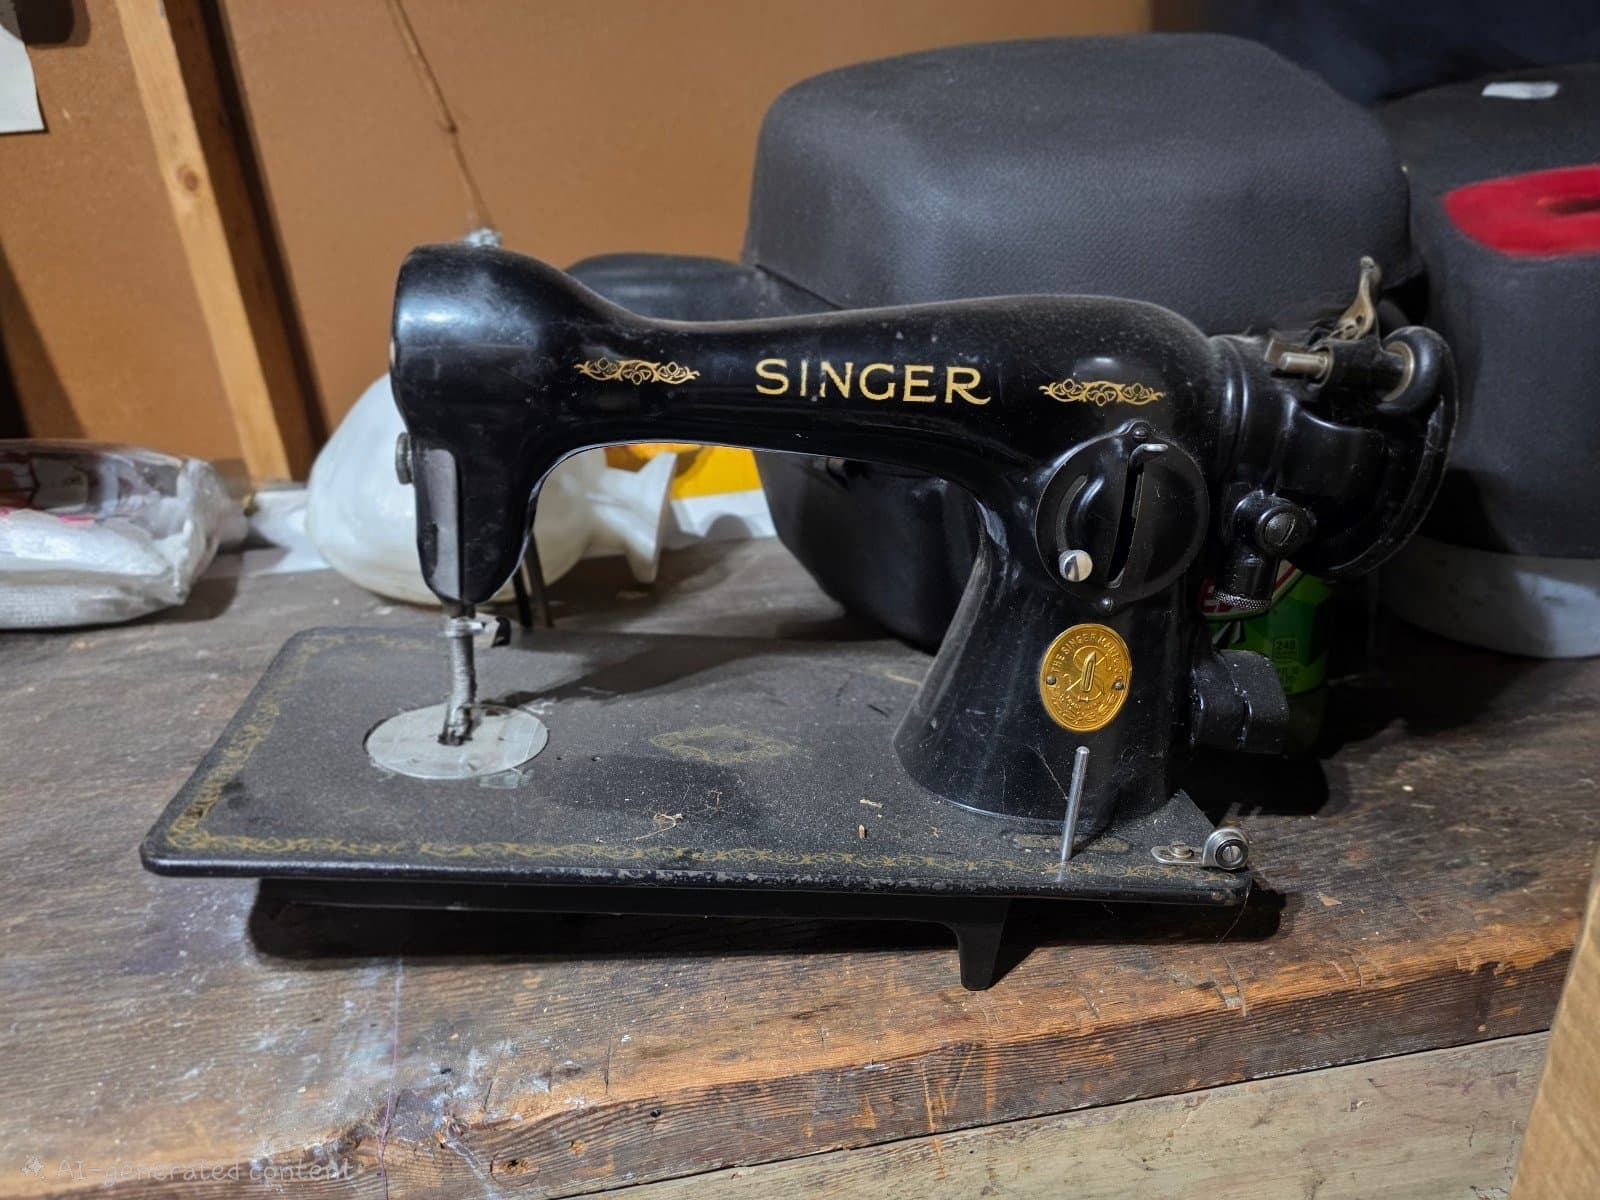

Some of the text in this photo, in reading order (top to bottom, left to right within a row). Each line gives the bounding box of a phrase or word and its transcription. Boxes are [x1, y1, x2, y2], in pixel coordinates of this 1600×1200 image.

[755, 358, 992, 405] SINGER
[1051, 653, 1066, 673] THE
[1060, 633, 1096, 656] SINGER
